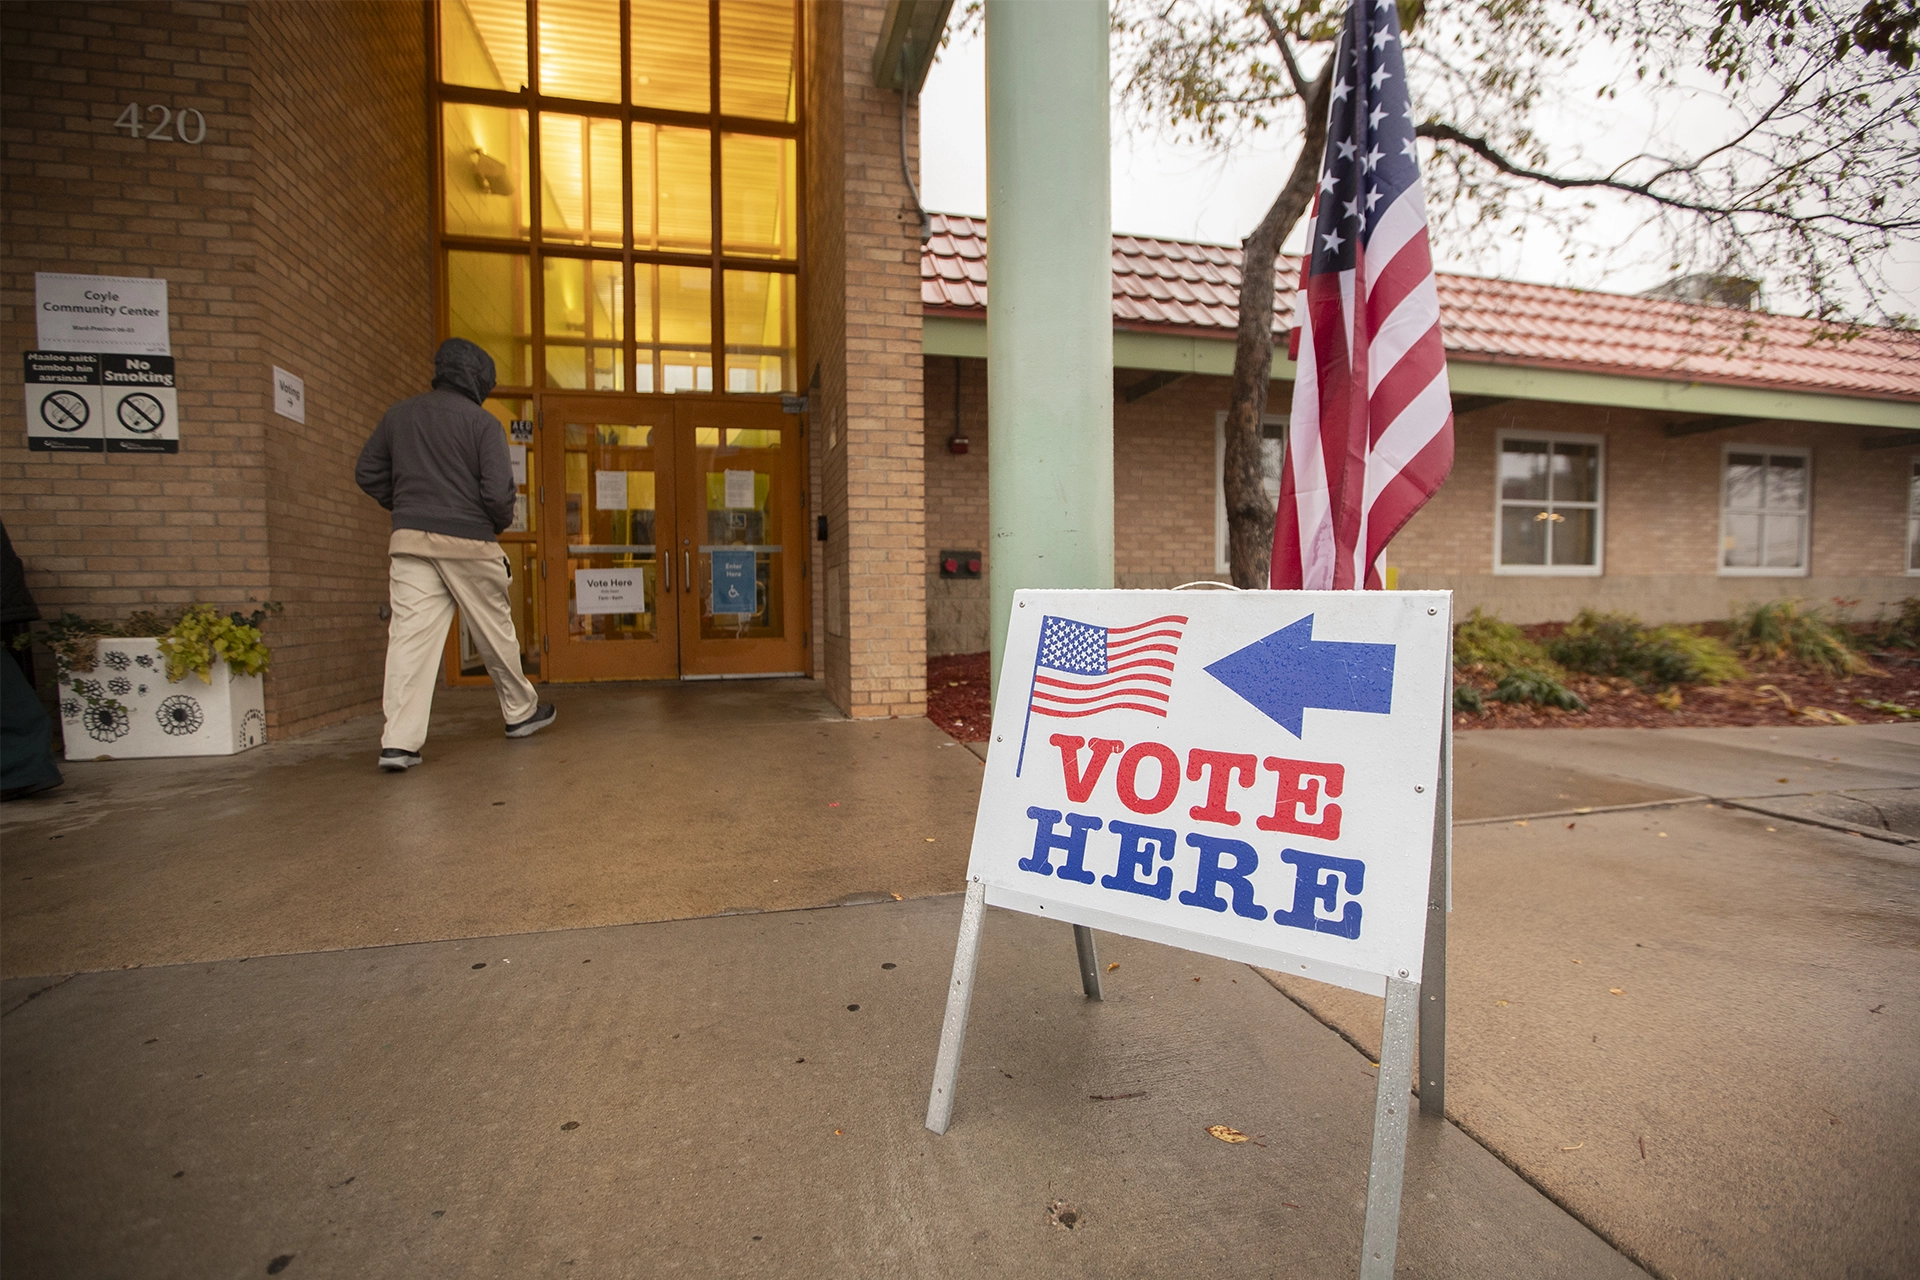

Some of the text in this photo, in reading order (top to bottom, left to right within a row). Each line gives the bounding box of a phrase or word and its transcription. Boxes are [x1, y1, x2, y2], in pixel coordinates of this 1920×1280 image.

[113, 102, 206, 144] 420
[84, 290, 120, 302] Coyle
[43, 301, 160, 317] Community Center
[28, 353, 66, 362] Maaloo
[125, 358, 151, 370] No
[32, 363, 94, 373] tamboo hin
[104, 370, 174, 386] Smoking
[279, 379, 301, 401] Voting
[512, 420, 532, 430] AED
[587, 578, 632, 587] Vote Here
[1049, 733, 1345, 841] VOTE
[1018, 806, 1365, 940] HERE
